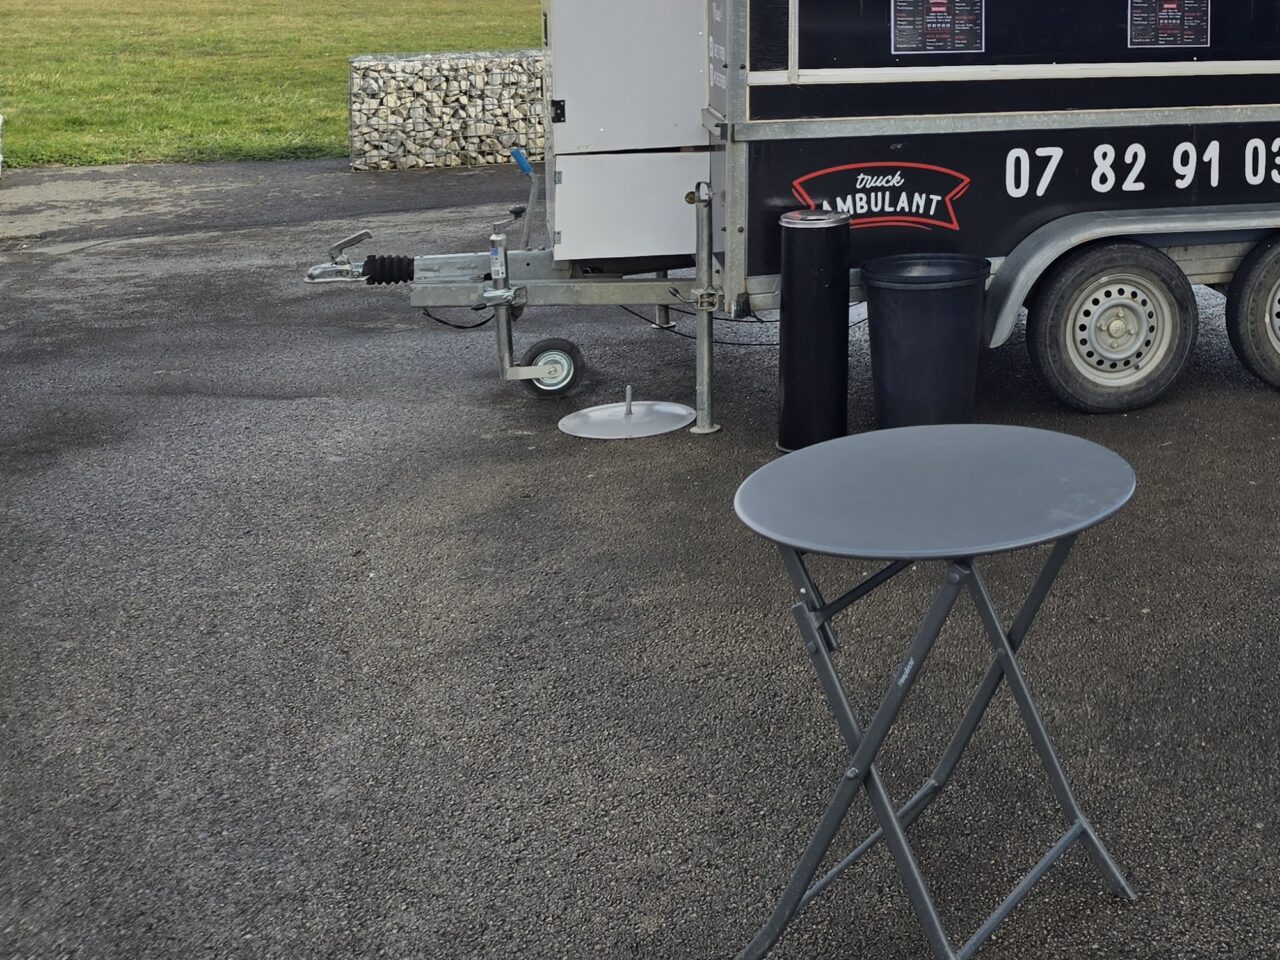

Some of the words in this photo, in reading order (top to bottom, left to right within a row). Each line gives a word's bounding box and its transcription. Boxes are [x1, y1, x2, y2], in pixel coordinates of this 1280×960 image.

[855, 170, 906, 189] truck
[1005, 146, 1064, 198] 07
[1091, 143, 1146, 193] 82
[1172, 140, 1220, 189] 91
[822, 191, 942, 216] AMBULANT
